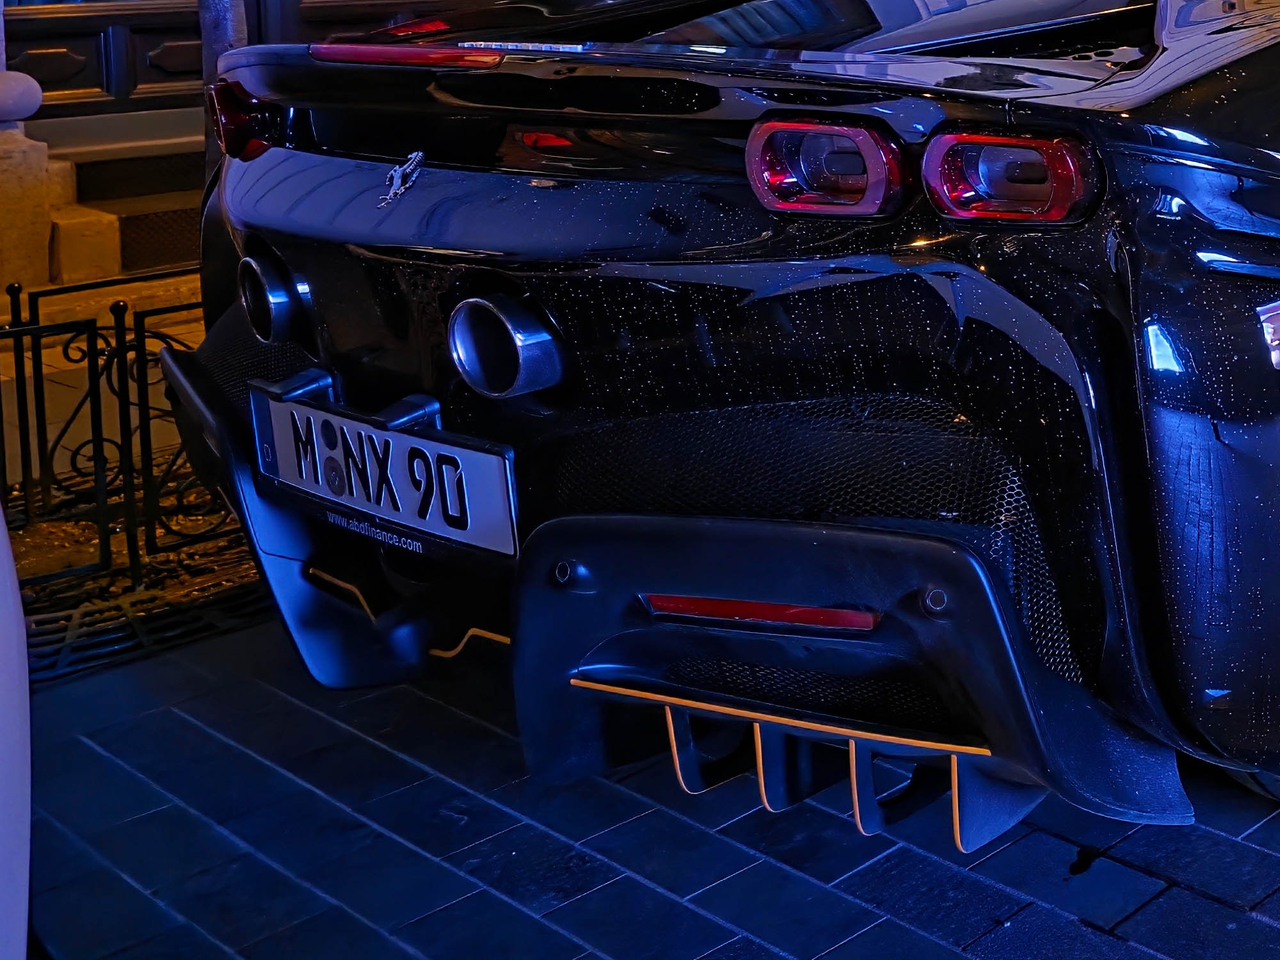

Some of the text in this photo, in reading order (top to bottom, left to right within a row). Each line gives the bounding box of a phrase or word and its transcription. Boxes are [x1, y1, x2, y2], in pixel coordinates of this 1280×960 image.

[290, 409, 471, 531] M NX 90
[326, 511, 423, 554] www.abdfinance.com
